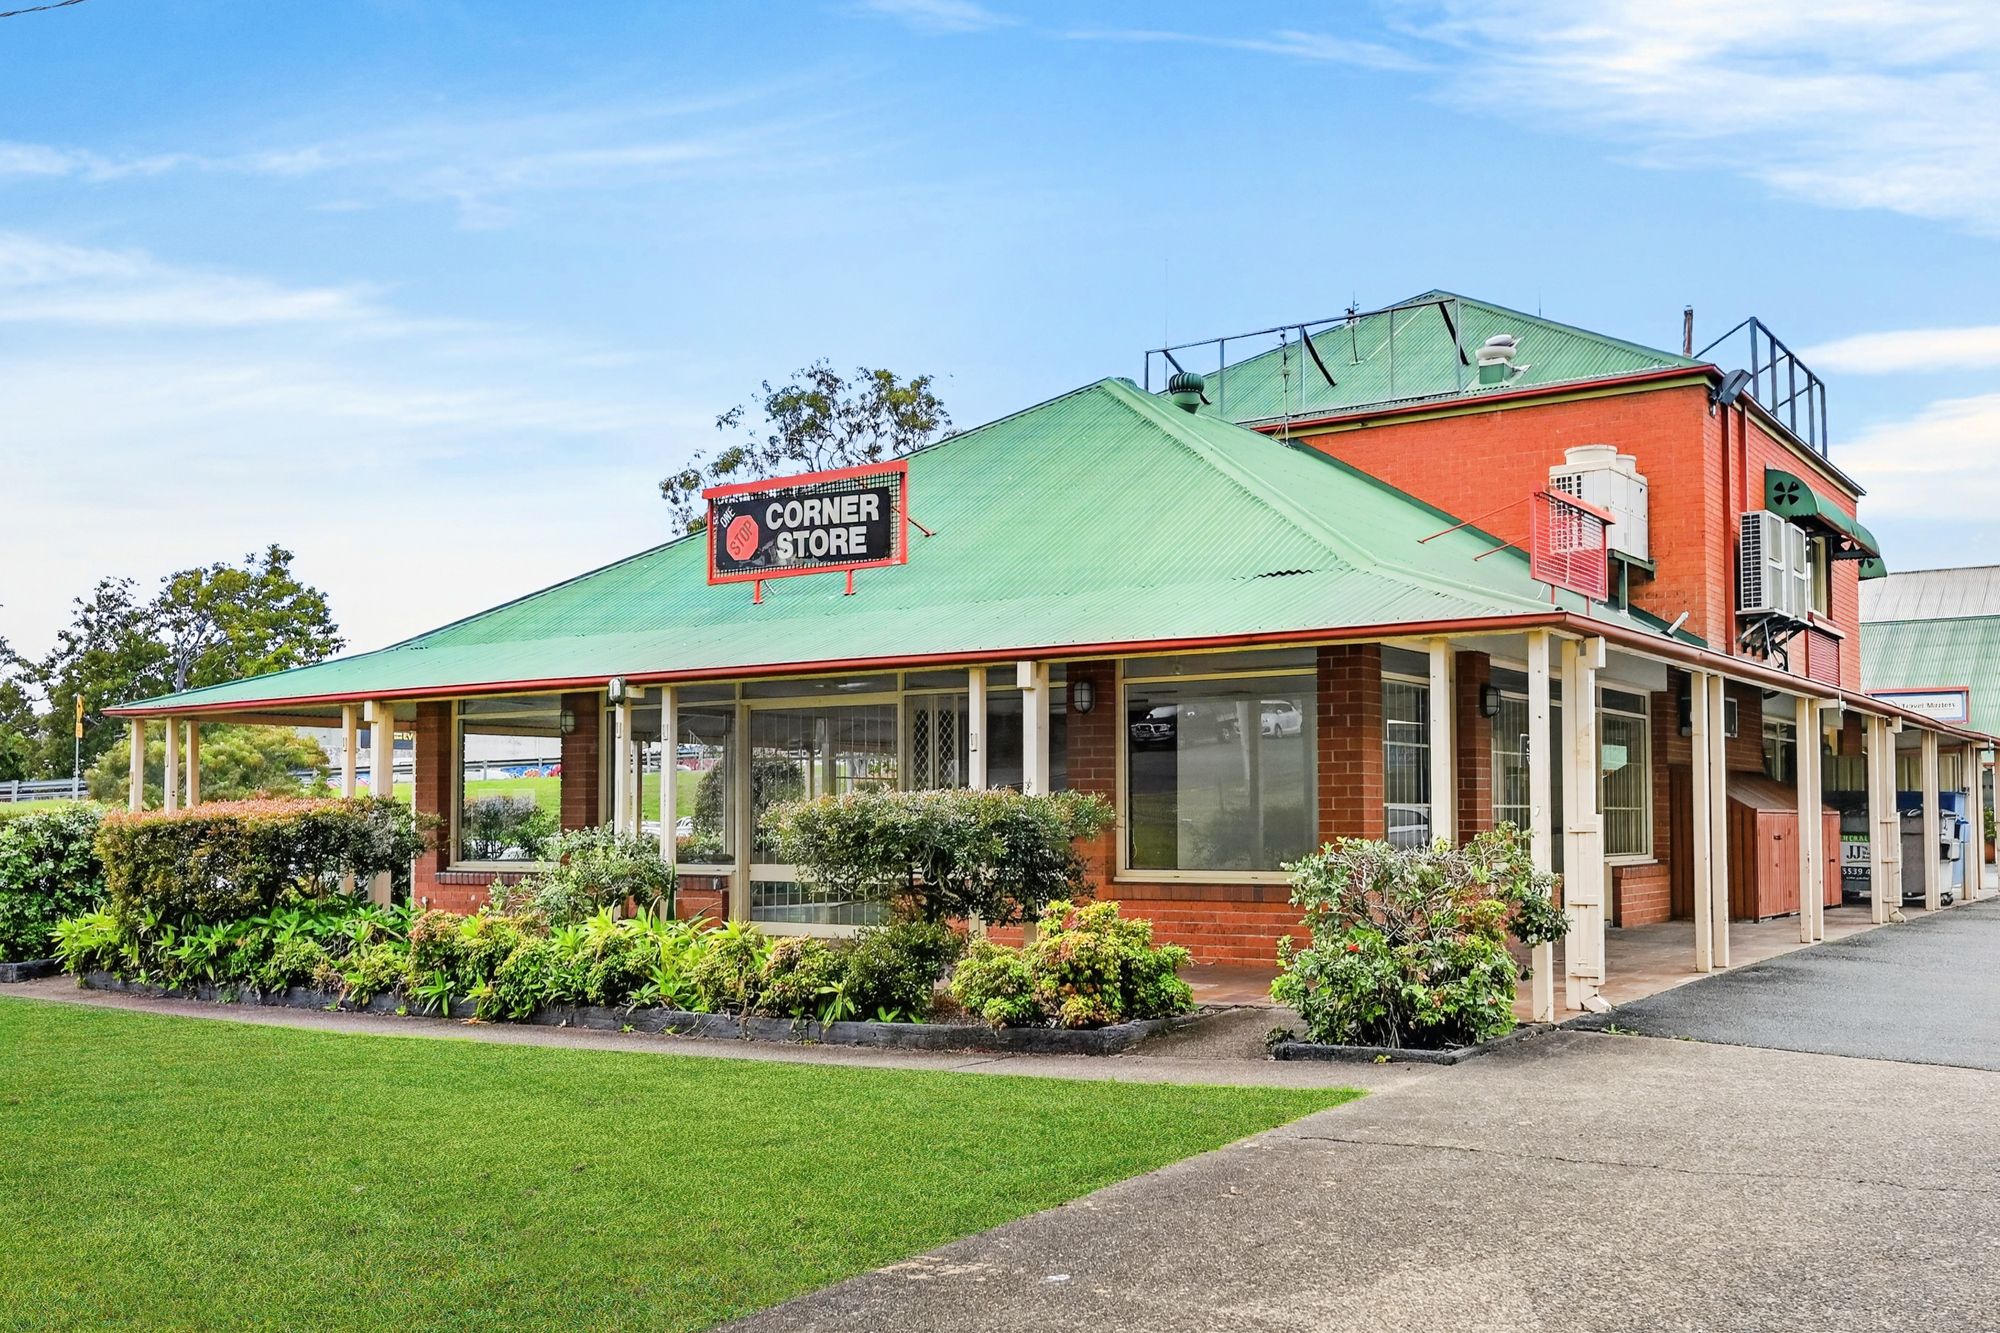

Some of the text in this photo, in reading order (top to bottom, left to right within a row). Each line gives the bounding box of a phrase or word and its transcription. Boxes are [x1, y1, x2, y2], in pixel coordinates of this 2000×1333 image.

[720, 506, 735, 528] ONE
[765, 493, 879, 530] CORNER
[730, 520, 753, 555] STOP
[776, 525, 867, 559] STORE
